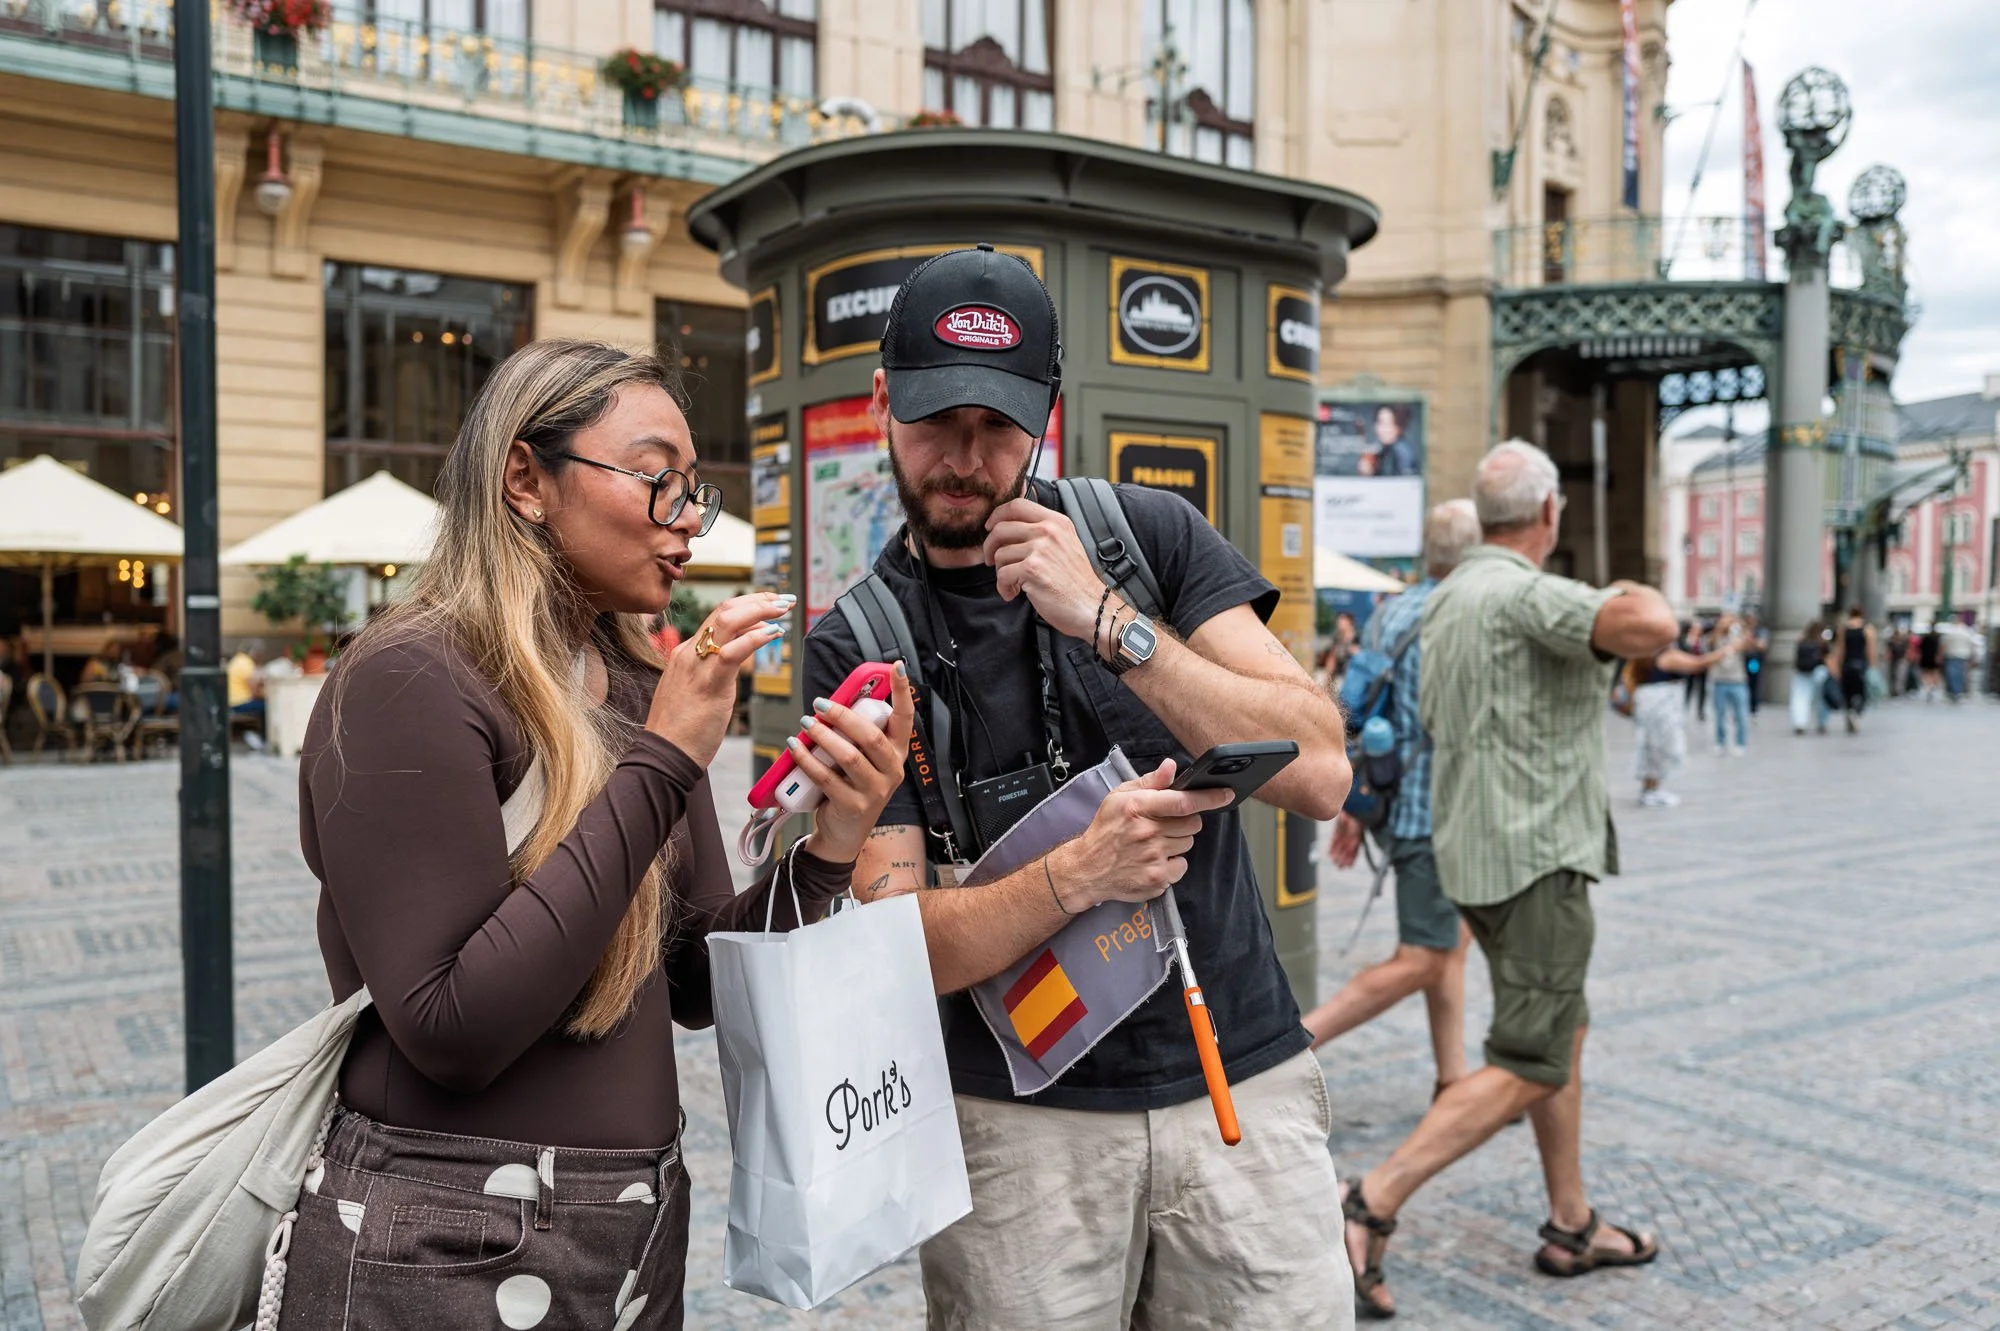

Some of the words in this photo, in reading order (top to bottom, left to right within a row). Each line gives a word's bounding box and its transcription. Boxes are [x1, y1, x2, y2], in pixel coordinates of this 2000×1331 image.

[958, 335, 999, 345] ORIGINALS
[998, 788, 1028, 803] FONESTAR
[1094, 902, 1152, 962] Prag
[826, 1060, 911, 1151] Pork's
